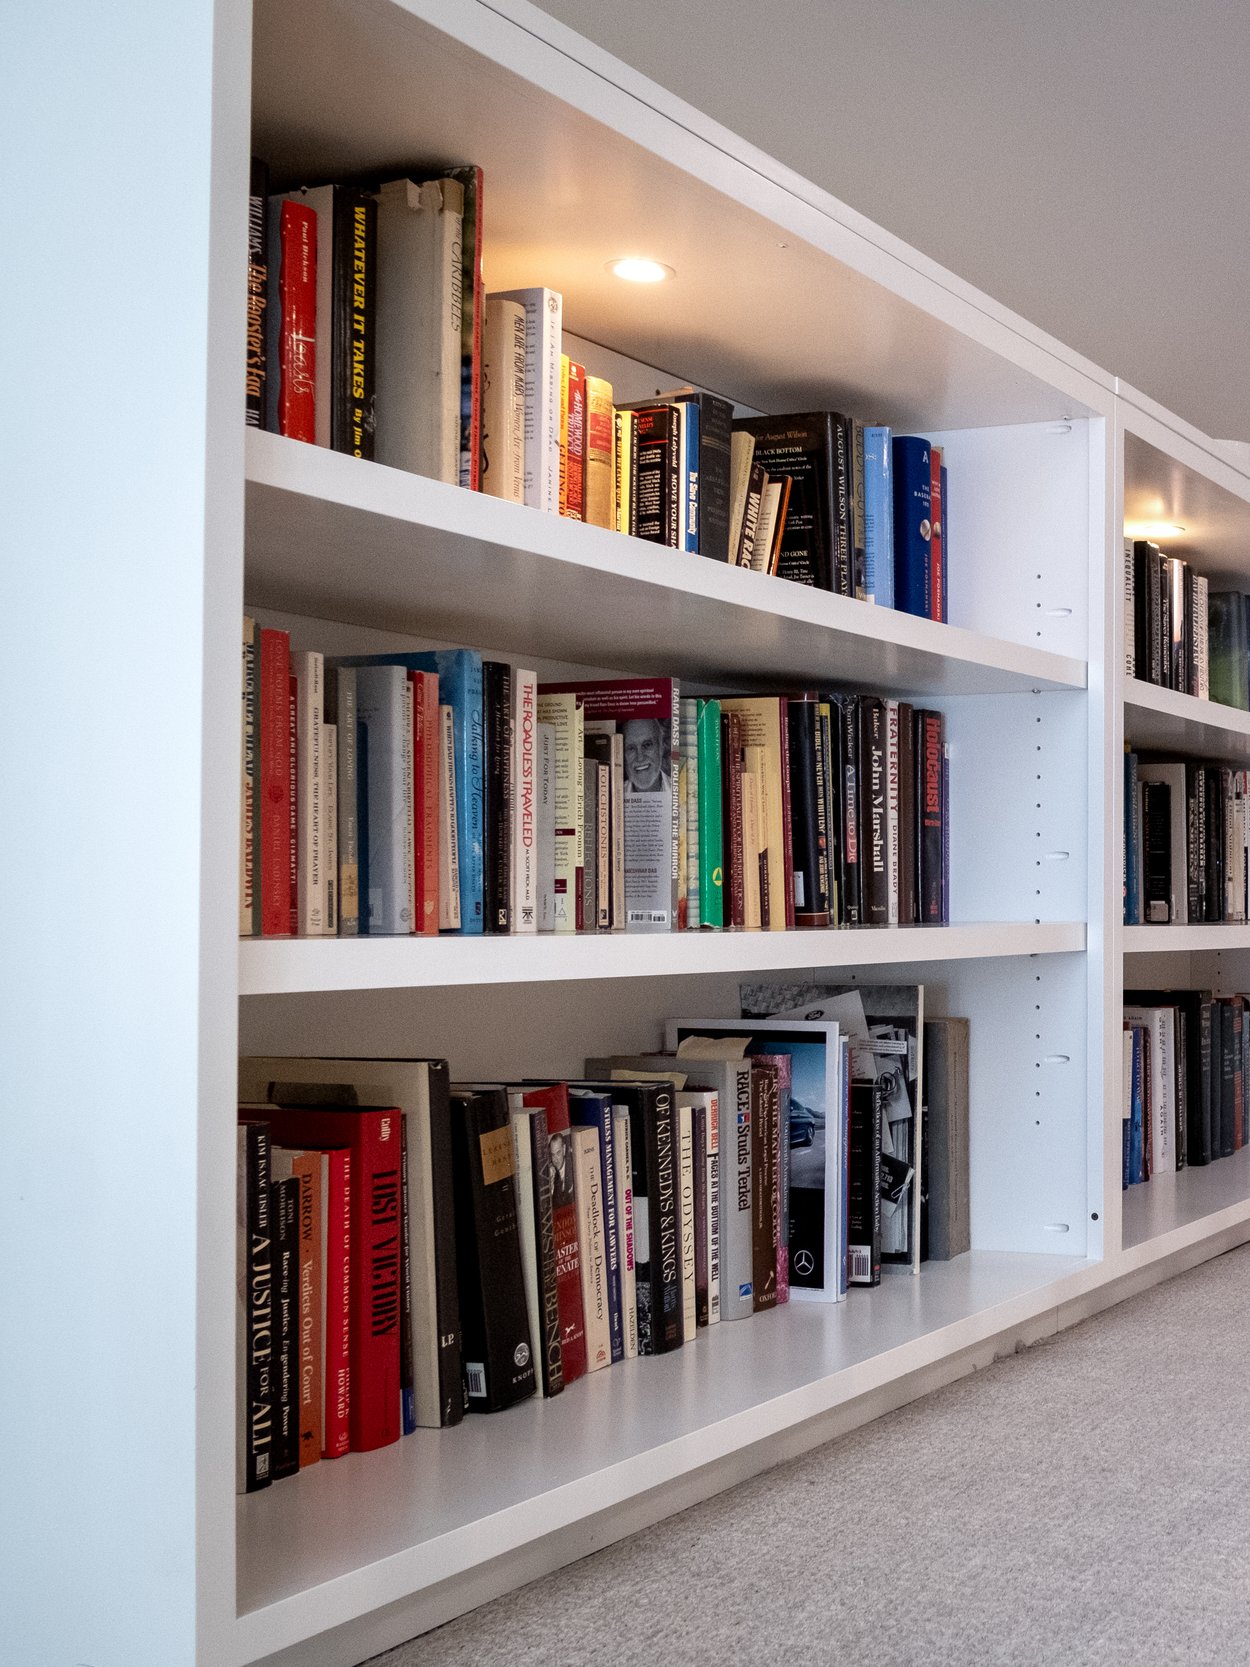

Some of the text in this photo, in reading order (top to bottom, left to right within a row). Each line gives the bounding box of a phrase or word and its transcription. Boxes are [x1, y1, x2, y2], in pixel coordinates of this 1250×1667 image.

[353, 206, 366, 310] WHATEVER
[353, 313, 366, 334] IT
[514, 315, 524, 334] MEN
[514, 334, 524, 348] ARE
[353, 339, 366, 399] TAKES
[514, 352, 524, 374] FROM
[574, 402, 583, 456] HOMEWOOD
[755, 446, 803, 456] BLACK BOTTOM
[837, 424, 845, 475] AUGUST
[513, 475, 522, 497] Venus
[670, 411, 679, 529] Joseph Lelyveld MOVE YOUR
[689, 472, 698, 482] The
[559, 500, 566, 516] TO
[745, 492, 760, 539] WHITE
[840, 524, 848, 560] THREE
[523, 683, 533, 710] THE
[470, 709, 483, 761] Talking
[503, 725, 510, 738] OF
[522, 710, 533, 752] ROAD
[472, 764, 481, 775] to
[523, 752, 533, 778] LESS
[889, 708, 898, 813] FRATERNITY
[926, 717, 941, 813] Holocaust
[471, 776, 483, 830] Heaven
[521, 781, 533, 848] TRAVELED
[600, 767, 608, 859] TOUCHSTONES
[847, 764, 857, 863] A Time to Die
[872, 708, 884, 872] Baker John Marshall
[312, 835, 319, 846] OF
[736, 1070, 751, 1212] RACE Studs Terkel
[875, 1139, 881, 1149] an
[604, 1143, 614, 1205] MANAGEMENT
[655, 1093, 676, 1283] OF KENNEDYS & KINGS
[707, 1099, 719, 1282] DERRICK BELL FACES AT THE BOTTOM OF THE WELL
[590, 1183, 602, 1239] Deadlock
[608, 1207, 616, 1226] FOR
[625, 1207, 632, 1216] OF
[625, 1217, 633, 1231] THE
[681, 1130, 693, 1282] THE ODYSSEY
[343, 1235, 350, 1250] OF
[371, 1169, 398, 1337] LOST VICTORY
[609, 1229, 617, 1271] LAWYERS
[625, 1232, 634, 1272] SHADOWS
[252, 1135, 272, 1455] KIM ISAAC EISLER A JUSTICE FOR ALL
[302, 1174, 313, 1406] DARROW Verdicts Out of Court
[594, 1255, 605, 1321] Democracy
[281, 1251, 290, 1437] Race-ing Justice, En-gendering Power
[545, 1290, 562, 1381] BENCH
[628, 1306, 636, 1351] HAZELDEN
[337, 1368, 345, 1418] HOWARD
